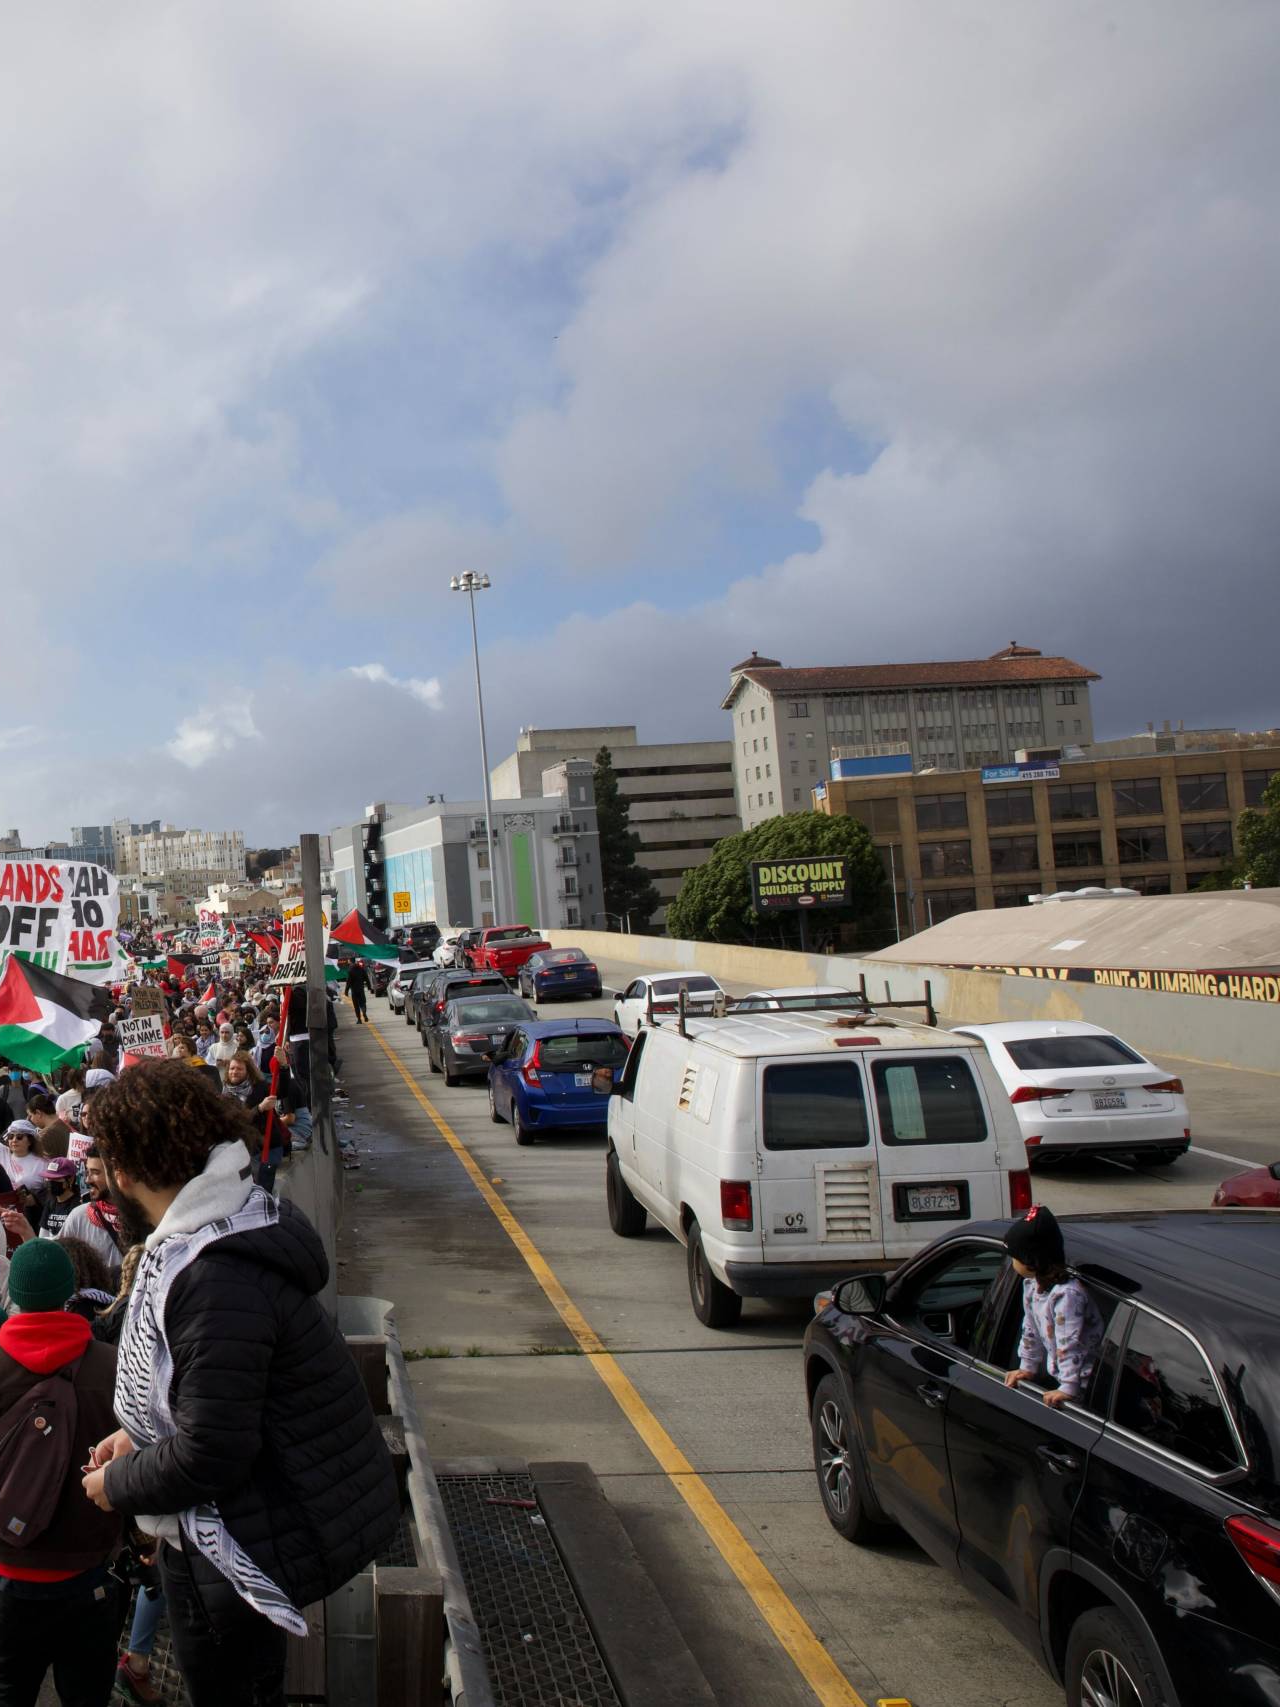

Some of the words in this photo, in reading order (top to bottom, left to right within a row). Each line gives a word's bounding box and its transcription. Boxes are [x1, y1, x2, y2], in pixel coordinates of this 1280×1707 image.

[984, 769, 997, 779] For
[999, 767, 1017, 778] Sale
[759, 862, 844, 884] DISCOUNT
[760, 883, 805, 896] BUILDERS
[810, 880, 846, 893] SUPPLY
[202, 953, 219, 965] STOP
[122, 1019, 140, 1033] NOT
[141, 1018, 152, 1029] IN
[123, 1034, 137, 1045] OUR
[137, 1029, 163, 1043] NAME
[148, 1045, 163, 1054] THE
